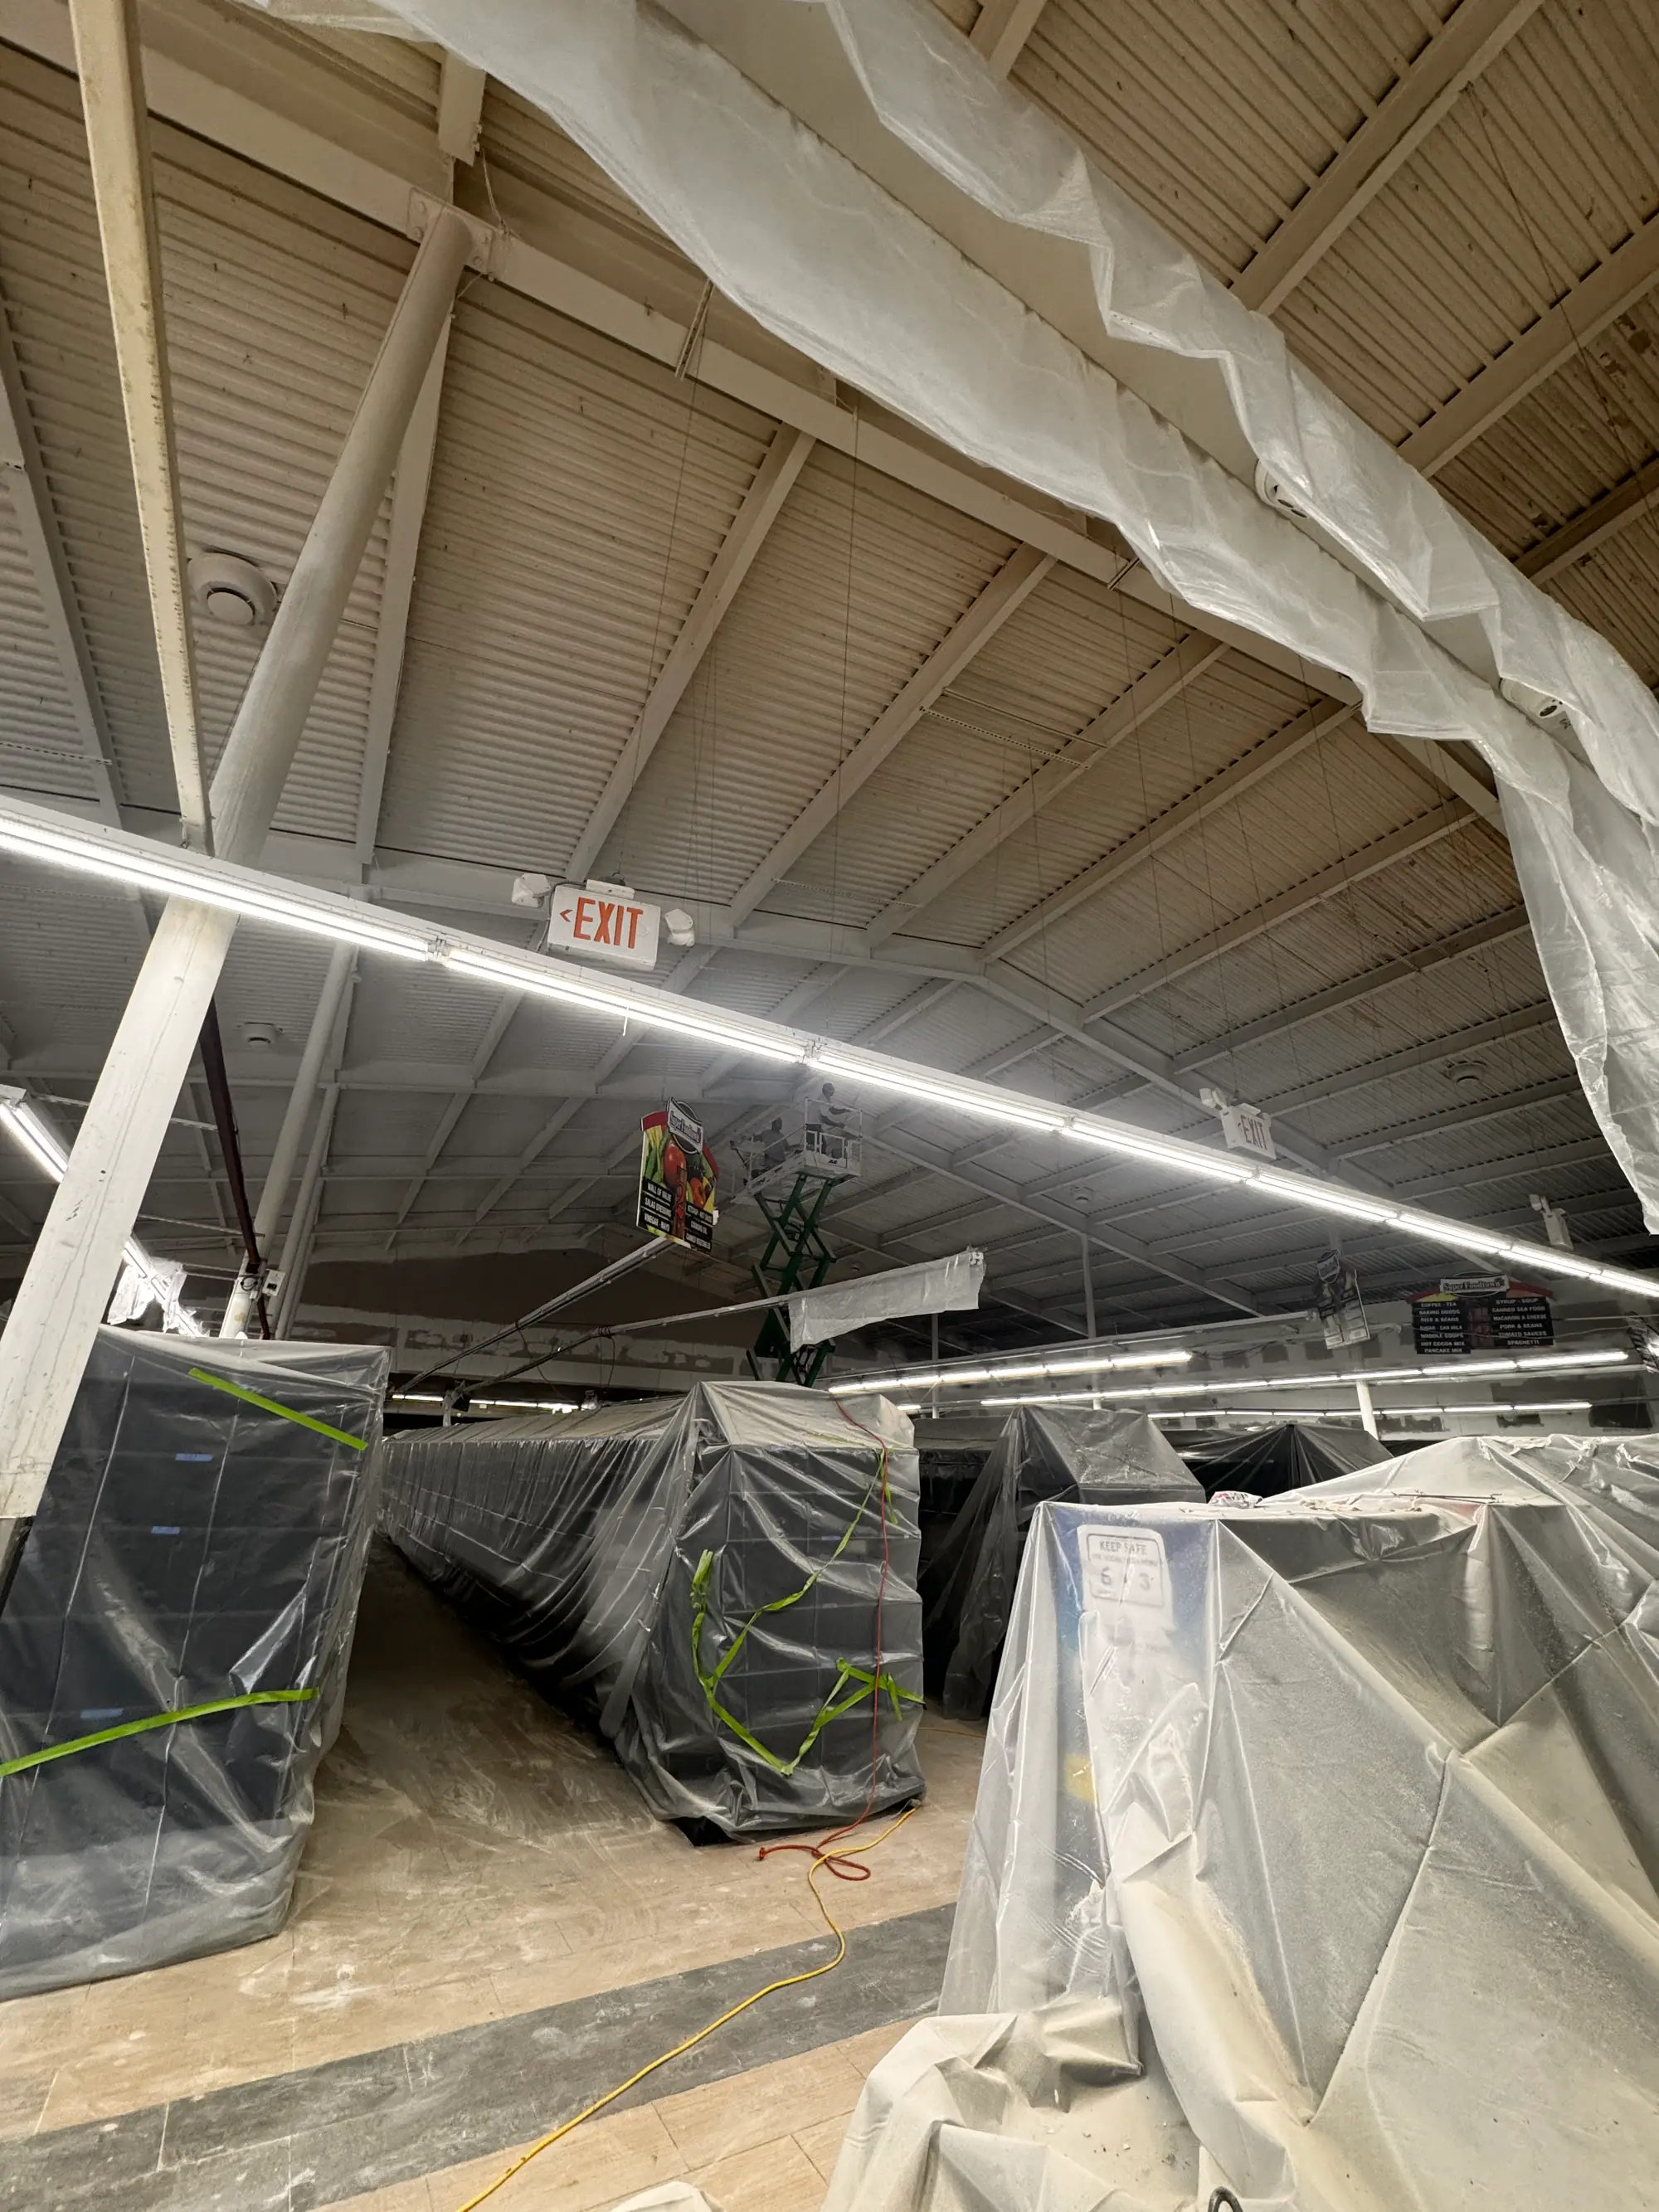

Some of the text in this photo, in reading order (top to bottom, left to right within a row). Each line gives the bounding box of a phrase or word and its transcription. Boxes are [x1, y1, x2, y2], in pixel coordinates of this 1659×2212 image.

[573, 897, 644, 949] EXIT
[1240, 1114, 1267, 1150] EXIT
[657, 1188, 662, 1196] OF
[645, 1197, 656, 1209] SALAD
[644, 1213, 659, 1226] VINEGAR
[660, 1221, 670, 1232] MAYO
[1100, 1540, 1148, 1555] KEEP SAFE
